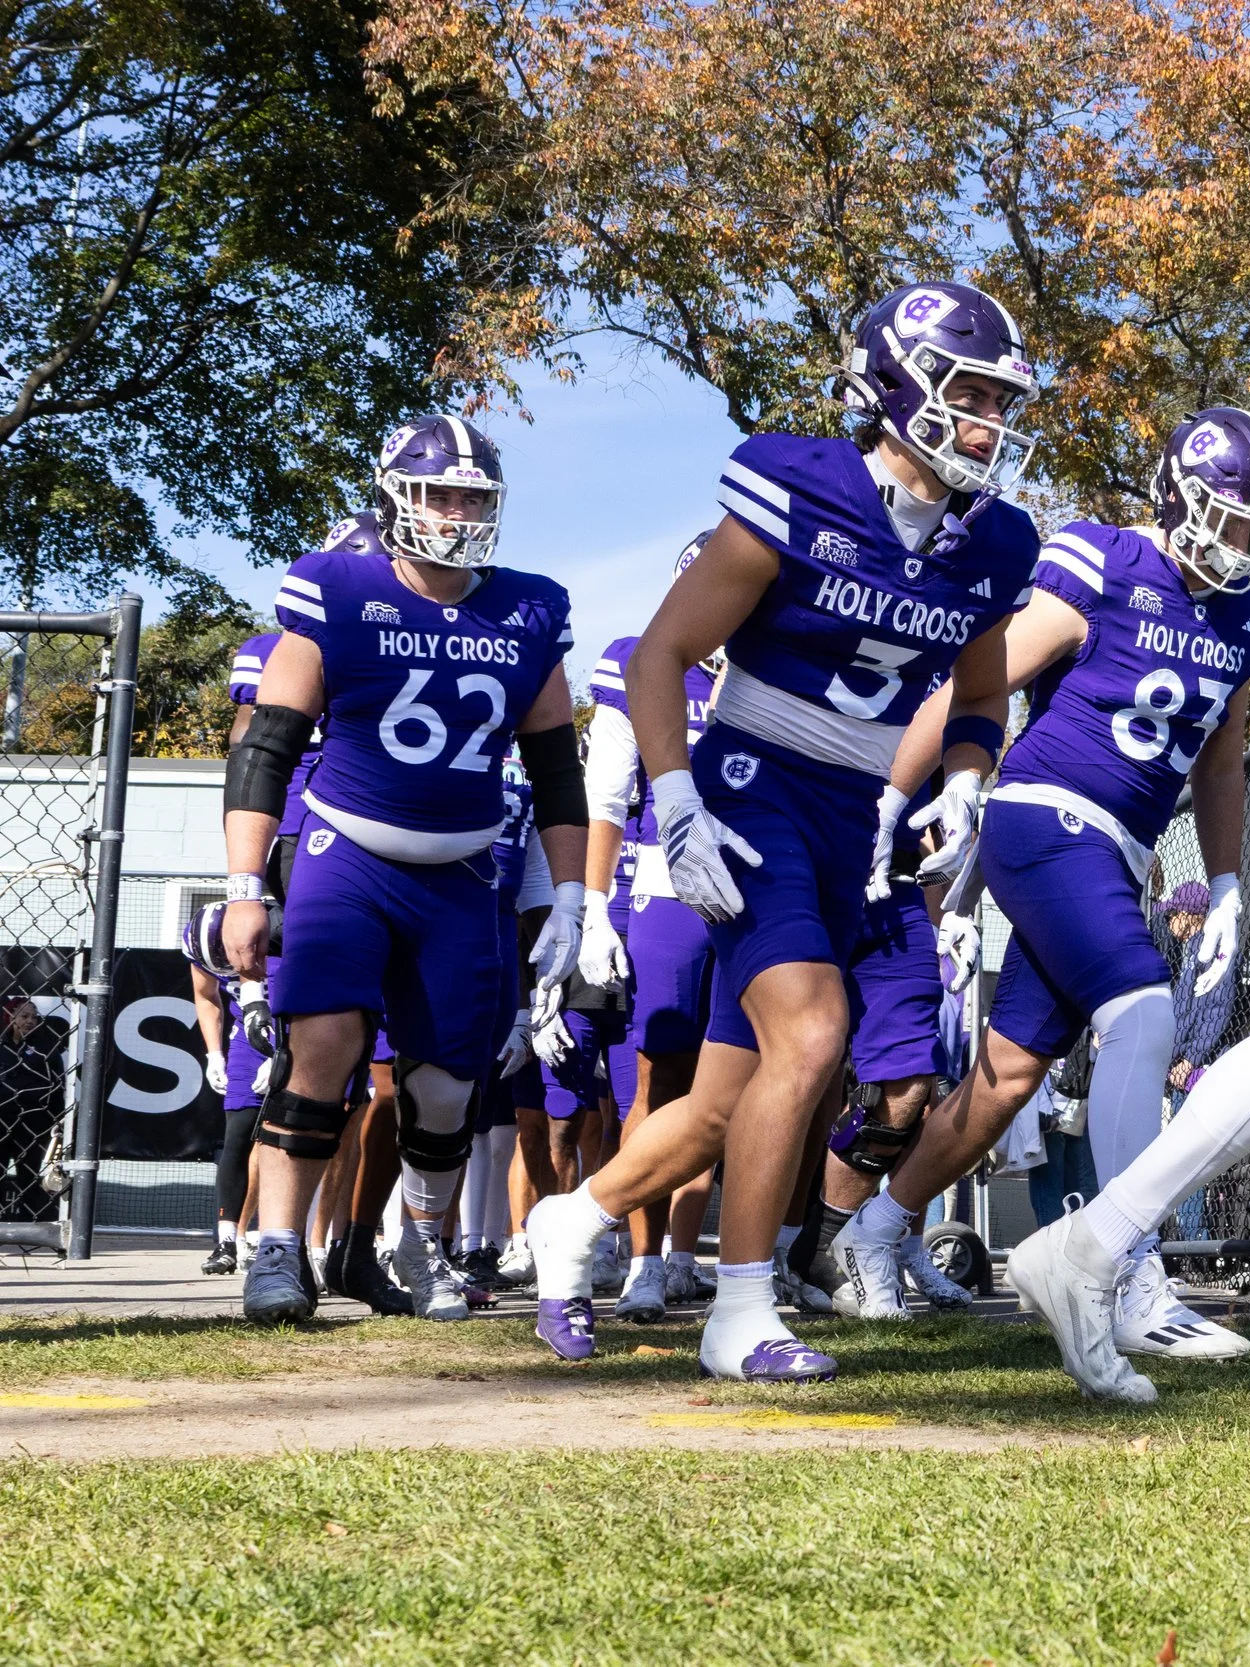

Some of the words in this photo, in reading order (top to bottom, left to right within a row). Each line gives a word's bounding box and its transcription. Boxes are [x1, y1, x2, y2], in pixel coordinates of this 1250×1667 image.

[809, 549, 858, 568] LEAGUE
[811, 542, 860, 560] PATRIOT
[813, 575, 893, 626] HOLY
[893, 599, 975, 646] CROSS
[379, 630, 440, 659] HOLY
[445, 635, 520, 666] CROSS
[1135, 620, 1189, 659] HOLY
[1190, 635, 1246, 674] CROSS
[824, 637, 923, 720] 3
[378, 668, 507, 772] 62
[1111, 668, 1234, 774] 83
